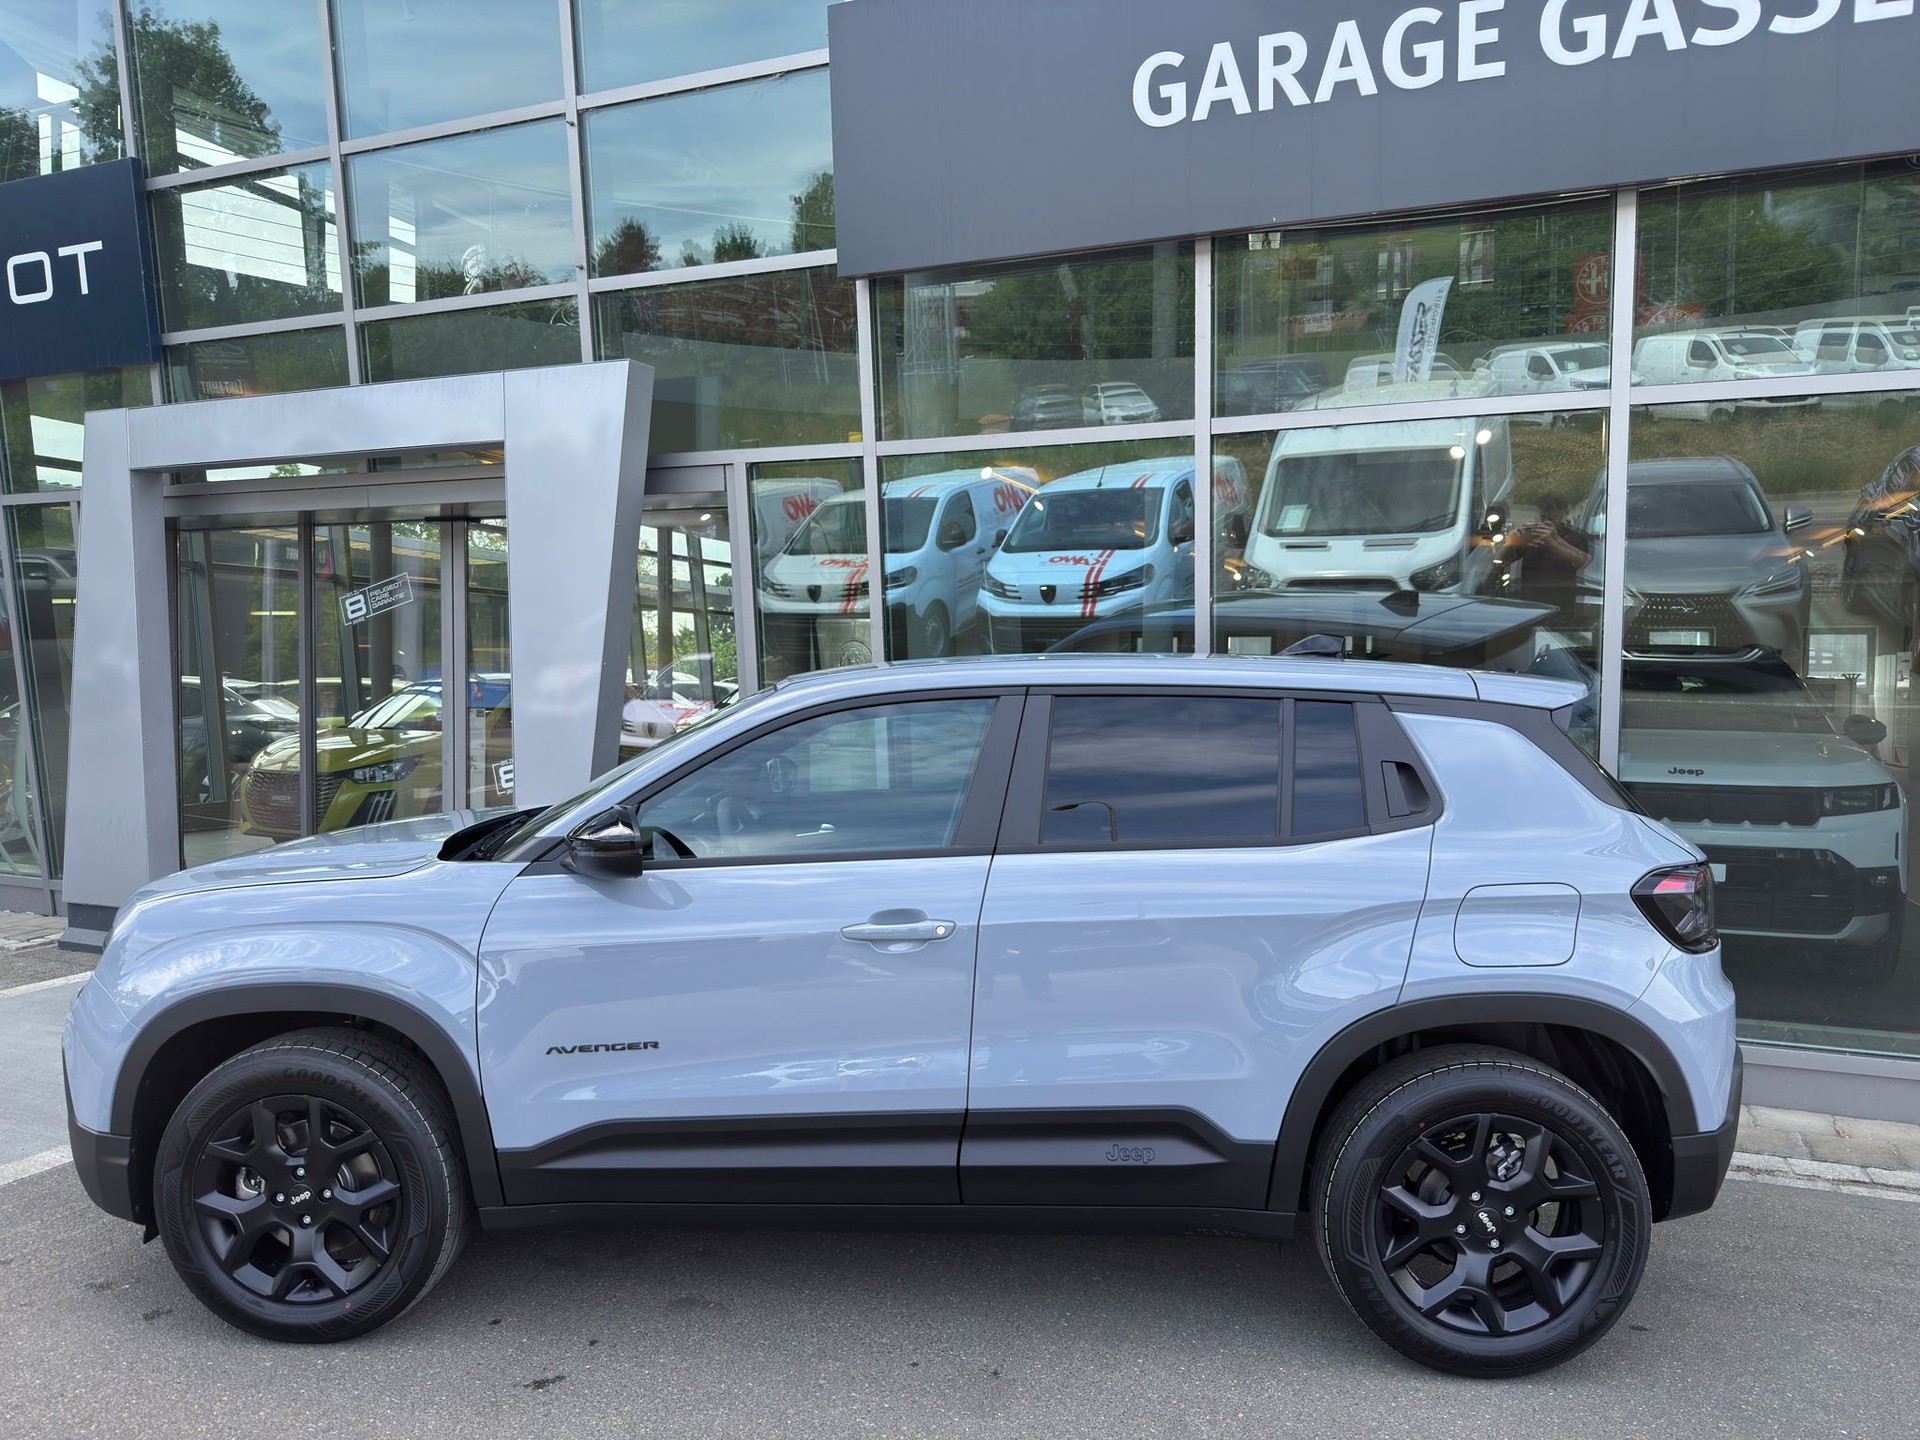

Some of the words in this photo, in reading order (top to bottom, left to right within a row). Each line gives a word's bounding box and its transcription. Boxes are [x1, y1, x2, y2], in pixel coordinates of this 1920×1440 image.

[1132, 0, 1506, 128] GARAGE
[1539, 0, 1914, 66] GAS
[7, 240, 103, 305] OT
[369, 580, 403, 598] PEUGEOT
[370, 592, 390, 603] CARE
[345, 594, 367, 620] 8
[371, 591, 406, 609] GARANTIE
[1667, 766, 1705, 776] Jeep
[545, 1040, 660, 1056] AVENGER
[1525, 1092, 1628, 1180] GOODYEAR
[1105, 1143, 1155, 1165] Jeep
[290, 1190, 311, 1205] Jeep
[1478, 1211, 1497, 1233] Jeep
